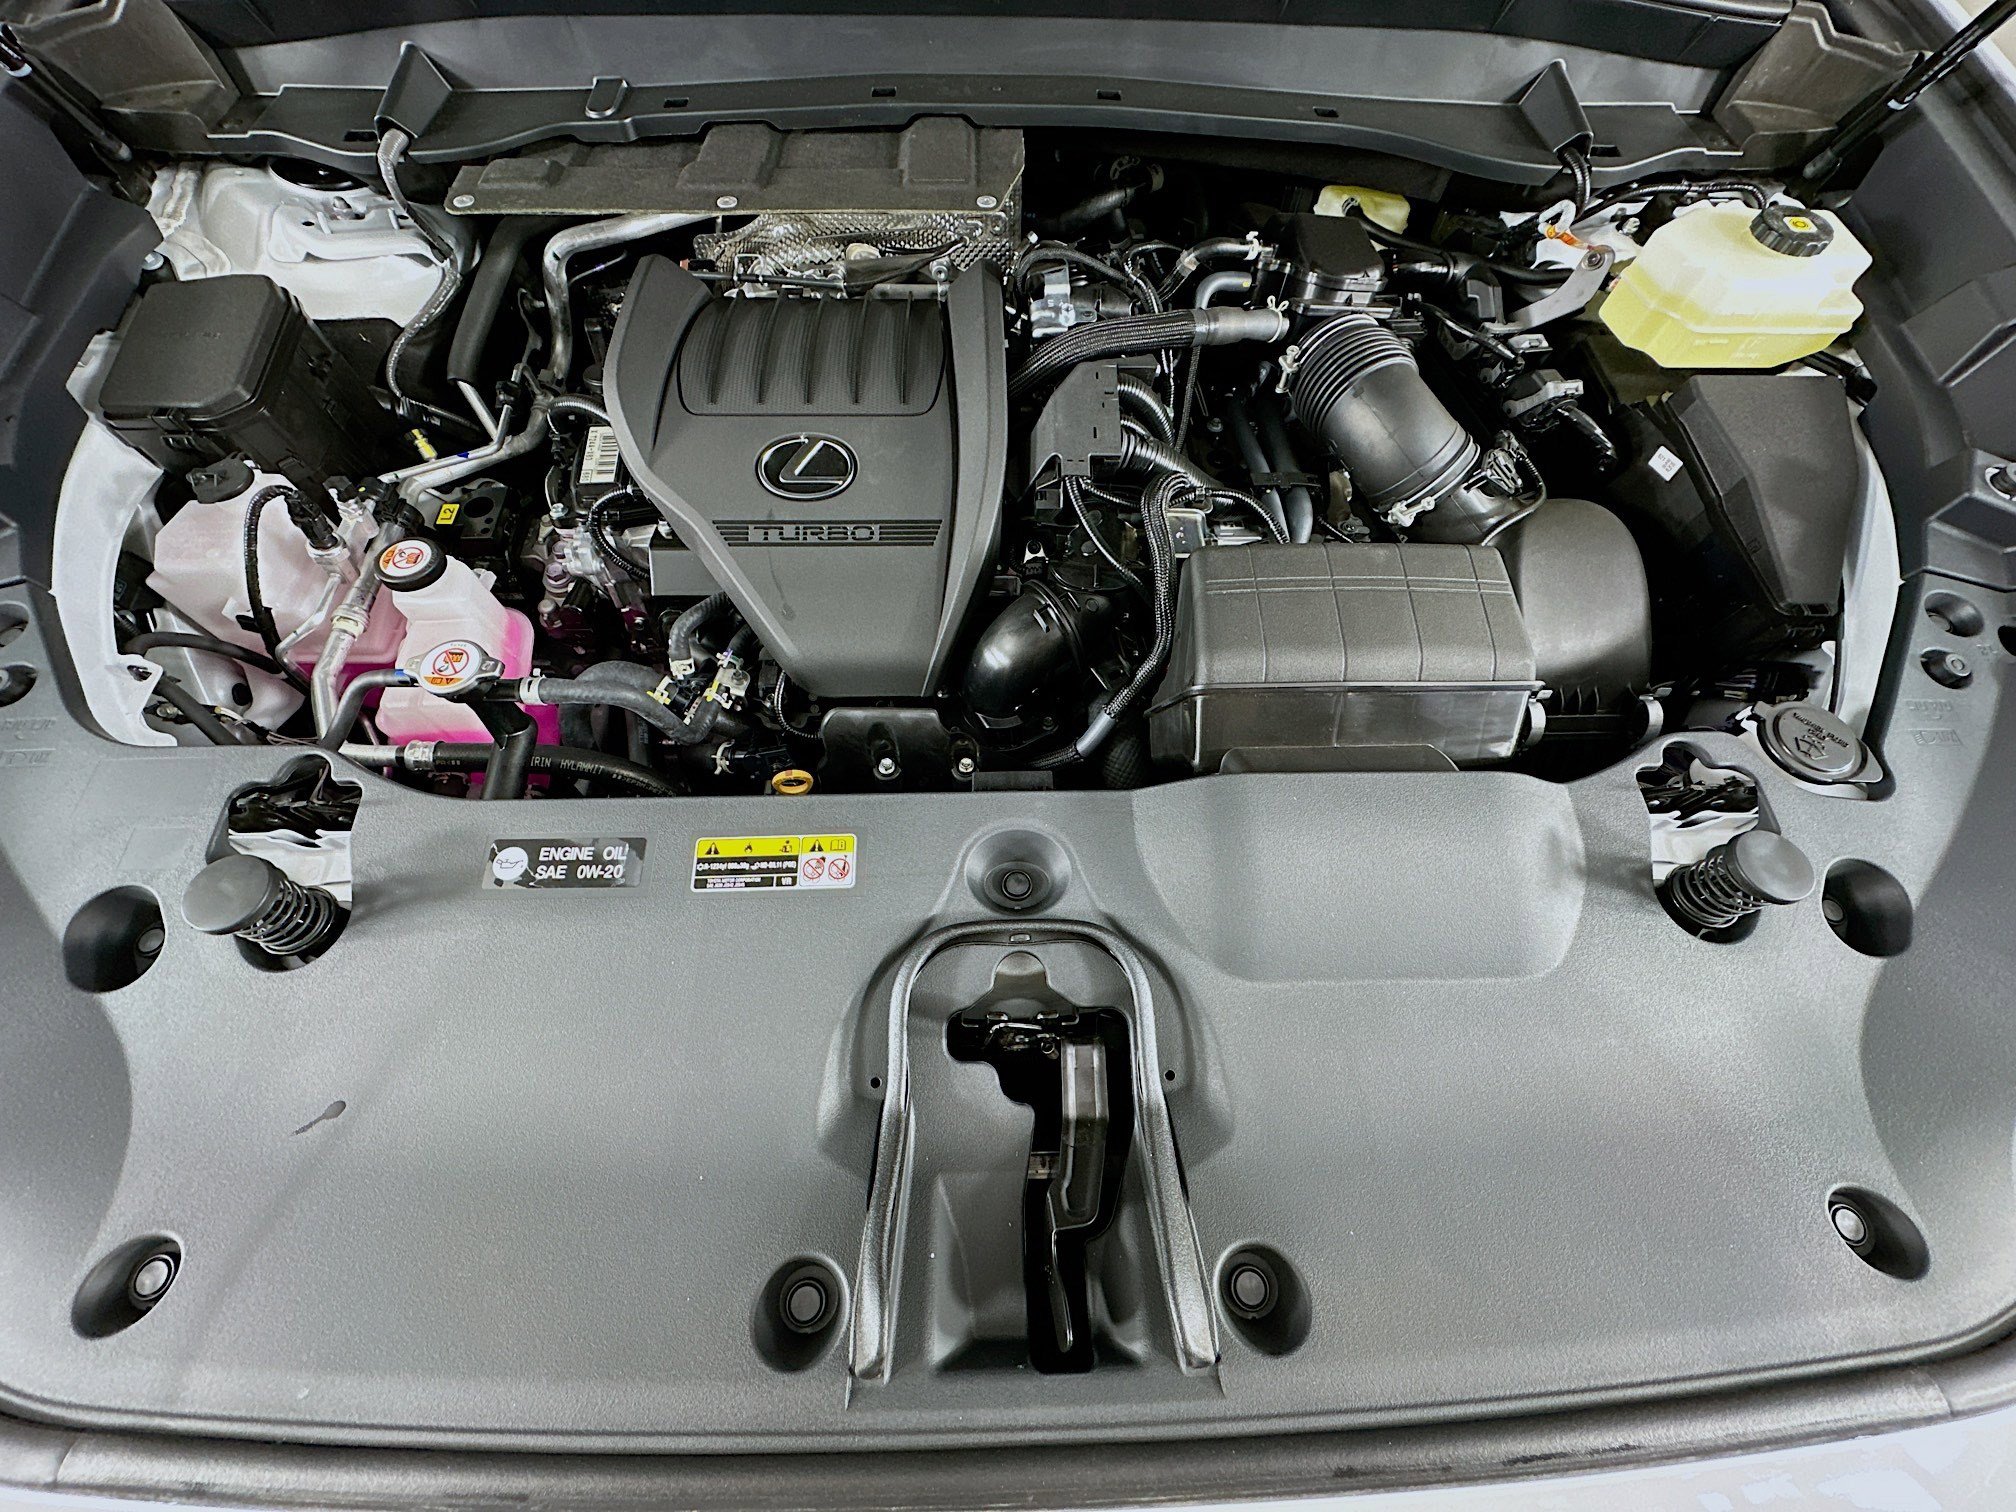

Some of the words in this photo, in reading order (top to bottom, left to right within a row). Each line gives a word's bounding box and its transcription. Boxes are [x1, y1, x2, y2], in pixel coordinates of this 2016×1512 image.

[440, 507, 456, 521] L2
[753, 525, 876, 541] TURBO
[538, 846, 595, 861] ENGINE
[602, 844, 628, 861] OIL
[535, 865, 568, 879] SAE
[576, 864, 624, 879] 0W-20
